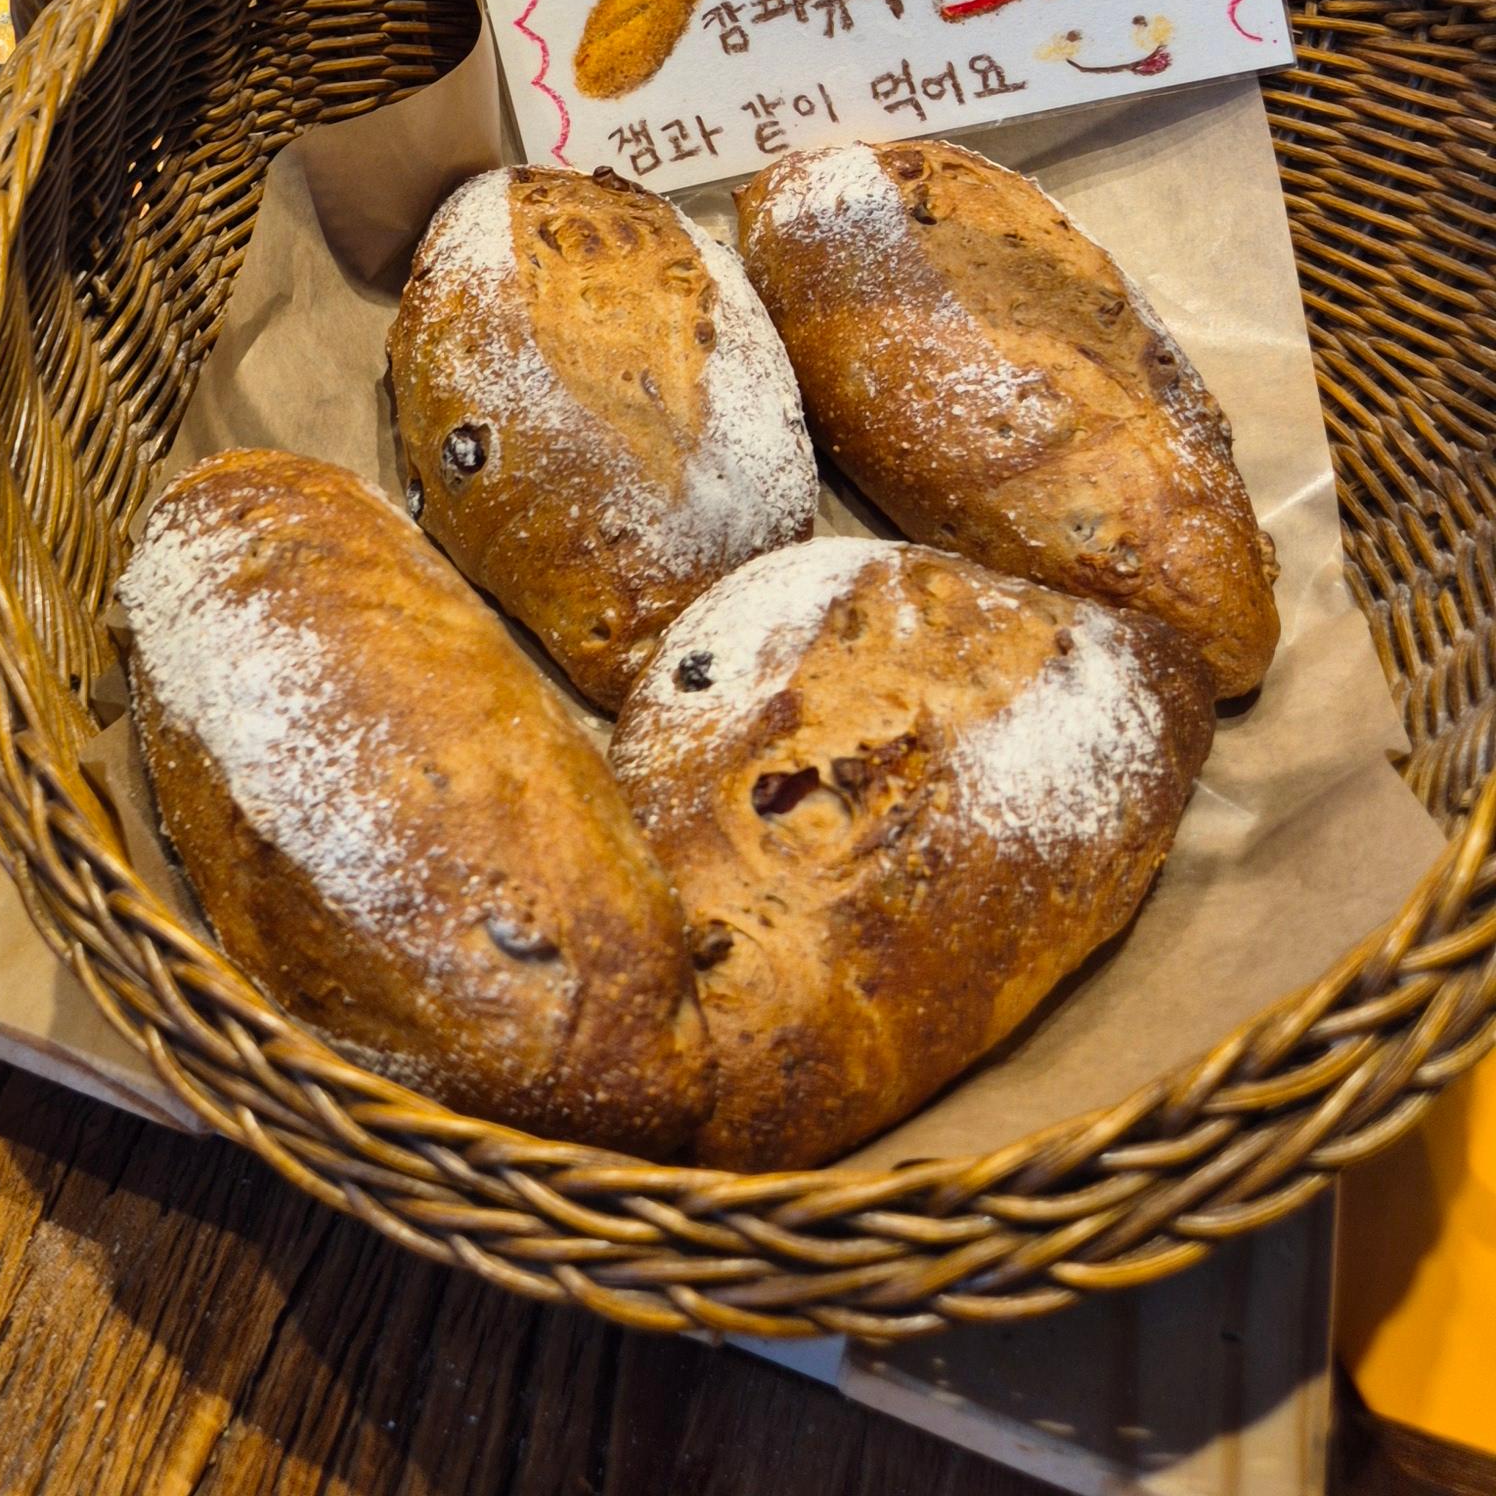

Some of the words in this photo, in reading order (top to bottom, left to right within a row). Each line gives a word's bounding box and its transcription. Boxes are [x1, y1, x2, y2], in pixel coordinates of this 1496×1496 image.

[608, 114, 725, 178] 잼과
[740, 81, 841, 155] 같이
[869, 53, 1029, 122] 먹어요
